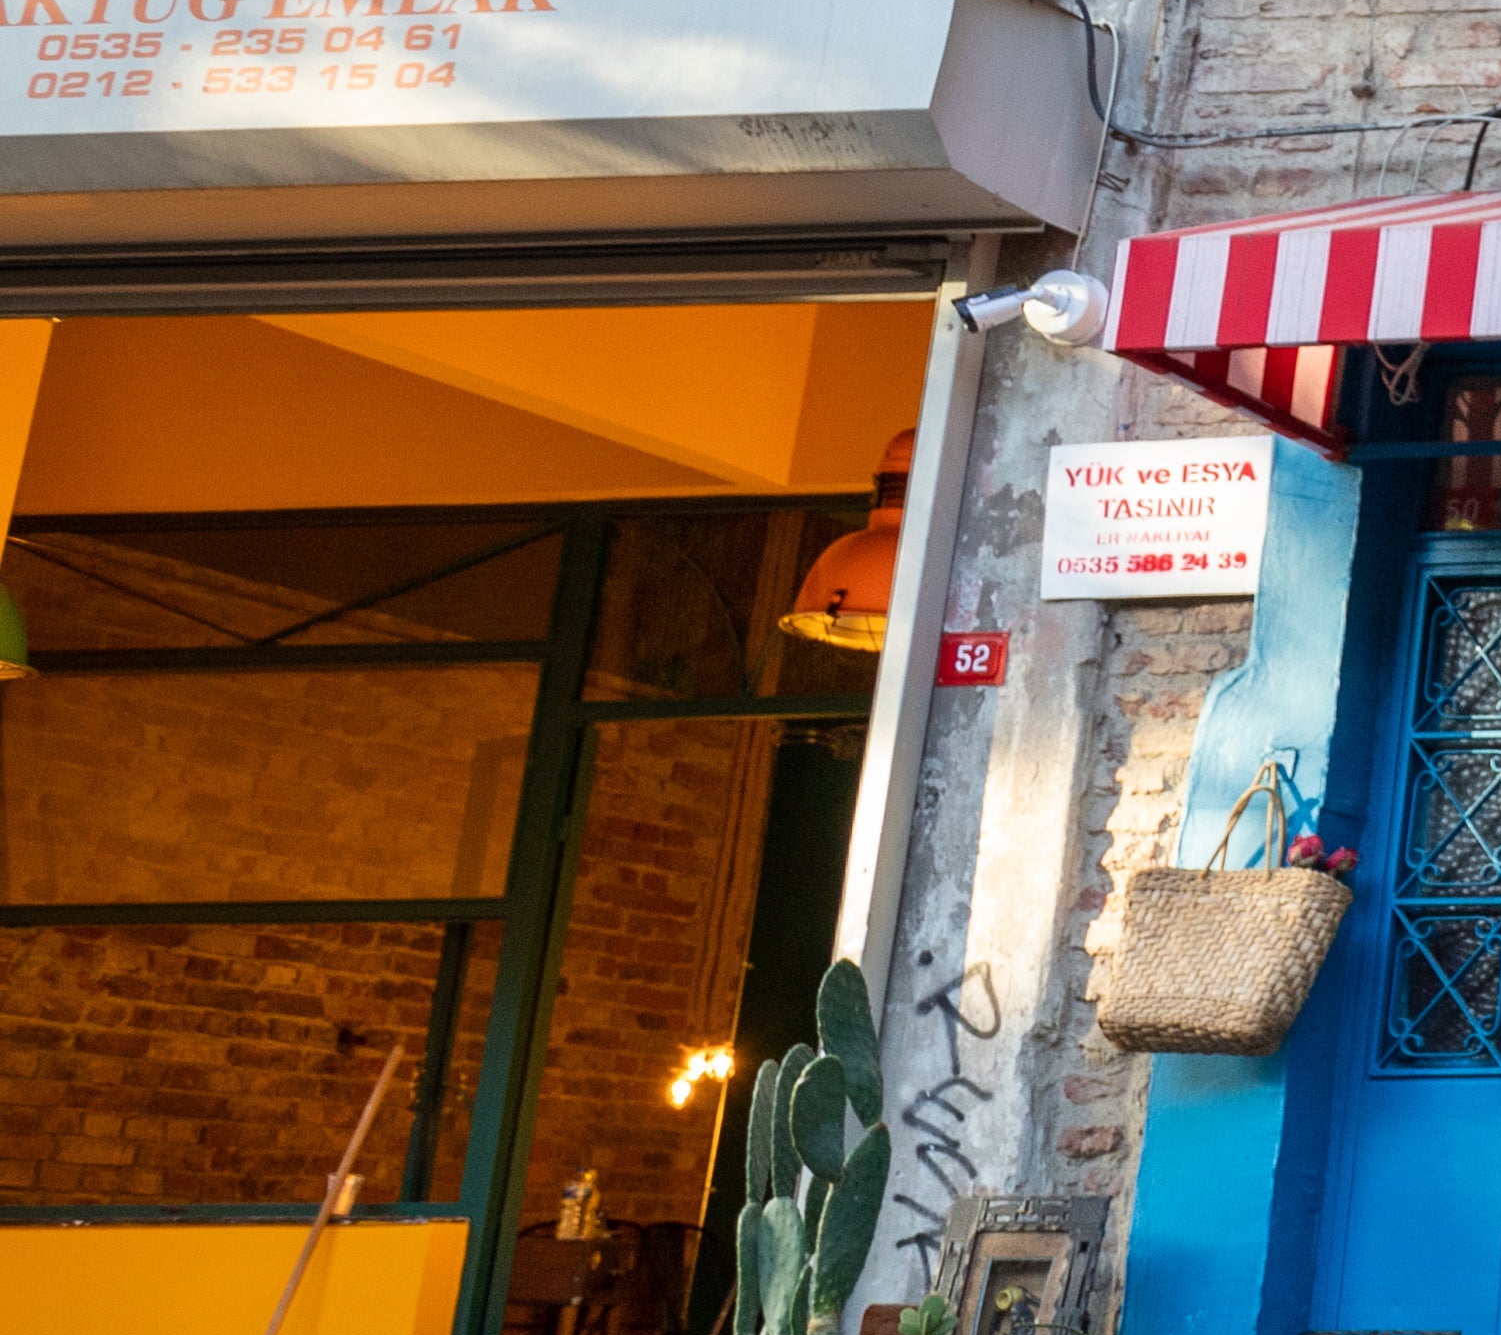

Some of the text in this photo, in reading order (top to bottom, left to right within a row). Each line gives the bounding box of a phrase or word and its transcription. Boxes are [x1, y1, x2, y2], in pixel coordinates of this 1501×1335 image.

[37, 31, 164, 62] 0535
[210, 27, 307, 57] 235
[323, 25, 386, 54] 04
[404, 23, 463, 51] 61
[27, 69, 154, 100] 0212
[203, 65, 298, 95] 533
[319, 63, 378, 91] 15
[394, 61, 457, 89] 04
[1065, 462, 1125, 487] YÜK
[1137, 467, 1171, 484] ve
[1057, 552, 1248, 574] 0535 586 24 39
[954, 644, 991, 673] 52
